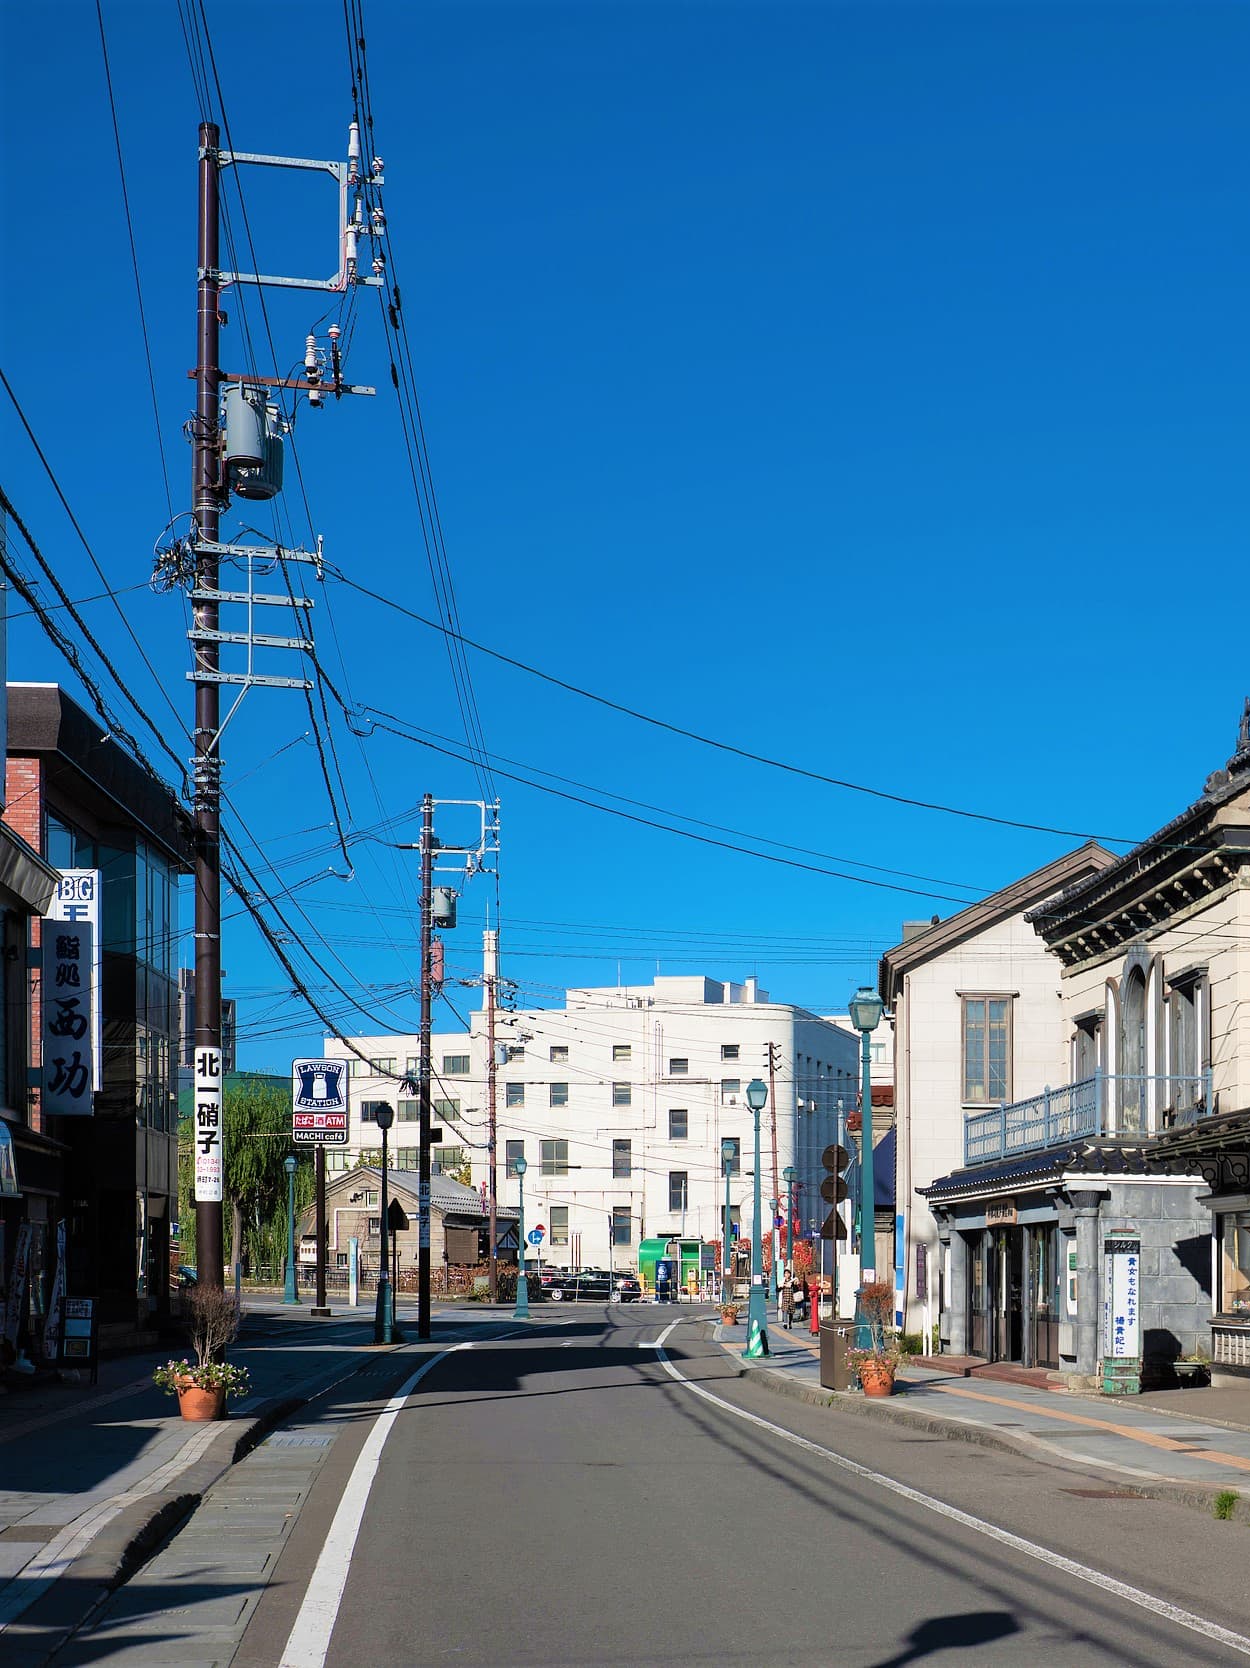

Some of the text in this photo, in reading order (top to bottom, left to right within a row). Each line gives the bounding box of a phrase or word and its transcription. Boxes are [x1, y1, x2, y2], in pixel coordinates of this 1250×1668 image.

[58, 876, 93, 900] BIG
[299, 1064, 340, 1074] LAWSON
[197, 1052, 220, 1155] 北一硝子
[299, 1097, 340, 1107] STATION
[326, 1116, 344, 1126] ATM
[296, 1132, 344, 1141] MACHI café
[1127, 1257, 1137, 1326] 貴女もなれます
